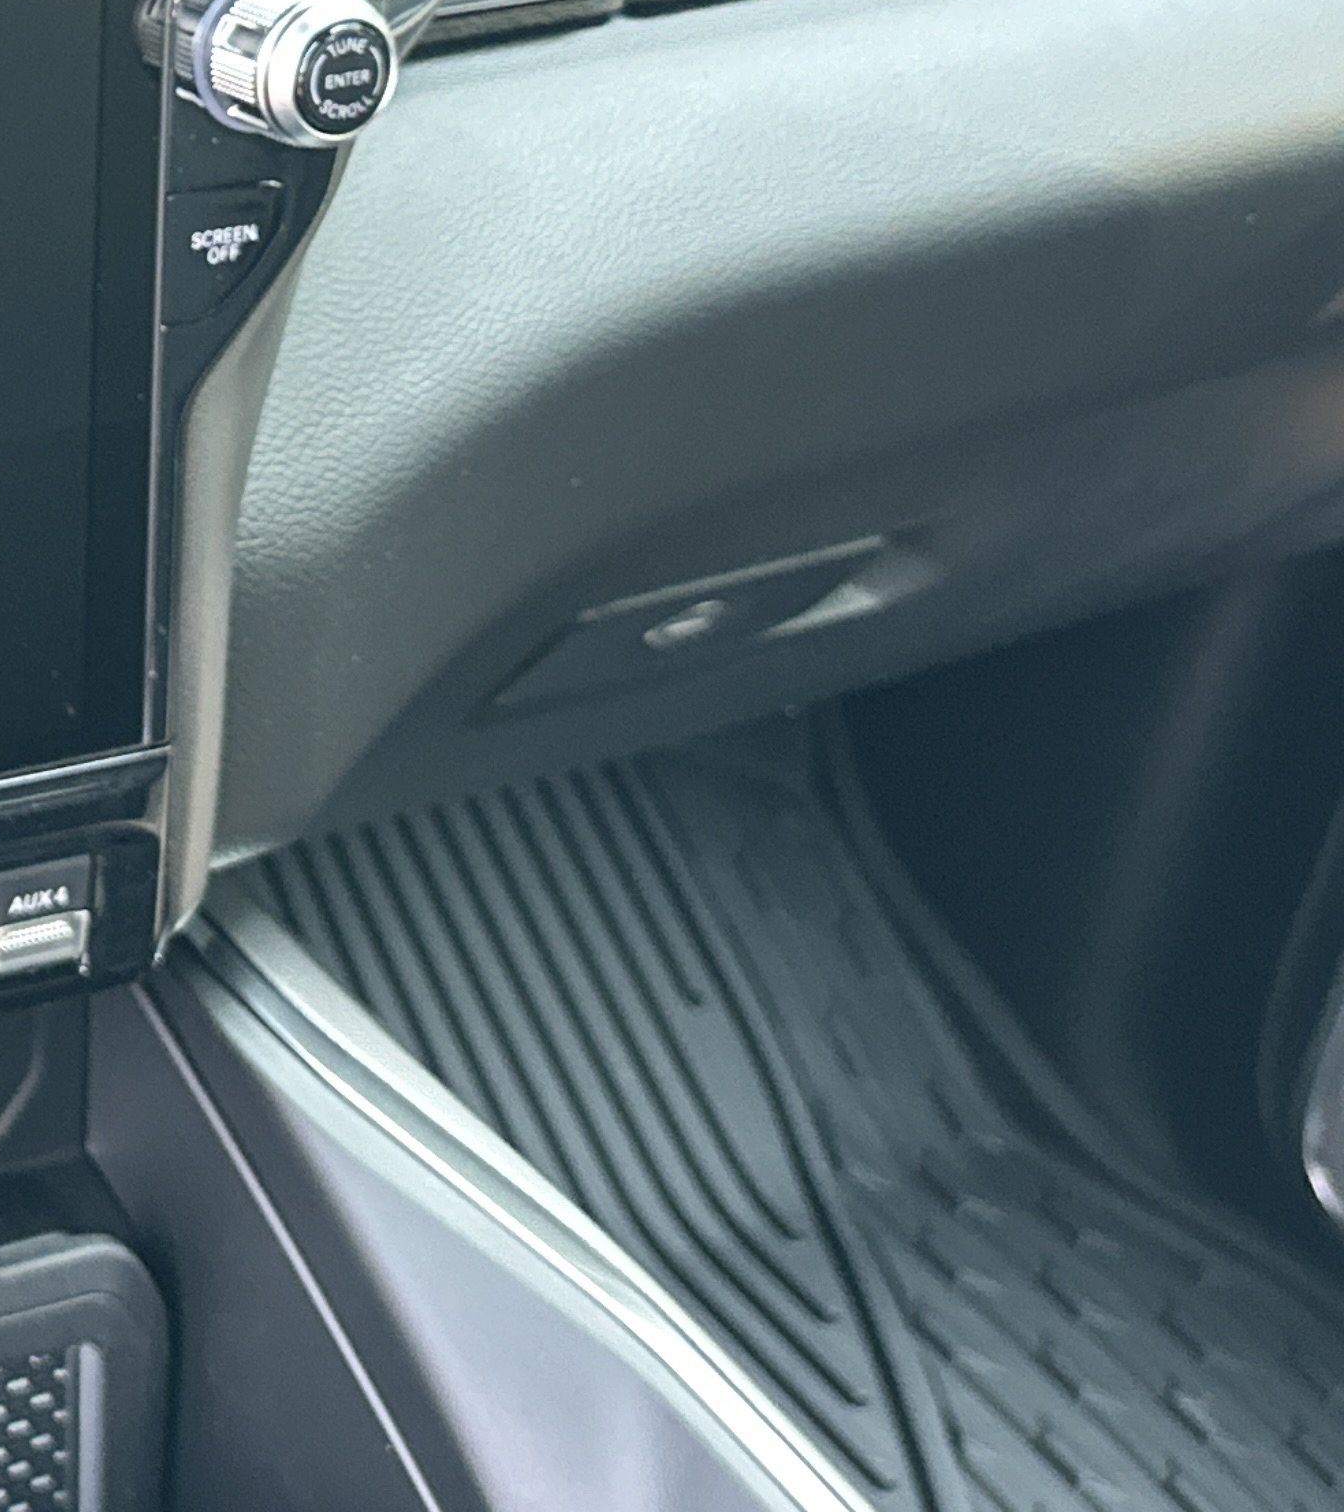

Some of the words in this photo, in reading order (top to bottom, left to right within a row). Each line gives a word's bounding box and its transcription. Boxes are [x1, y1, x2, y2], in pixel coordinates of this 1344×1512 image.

[325, 38, 369, 59] TUNE
[324, 68, 371, 90] ENTER
[319, 96, 373, 121] SCROLL
[190, 223, 260, 251] SCREEN
[206, 244, 242, 266] OFF
[8, 892, 54, 916] AUX
[52, 886, 71, 908] 4
